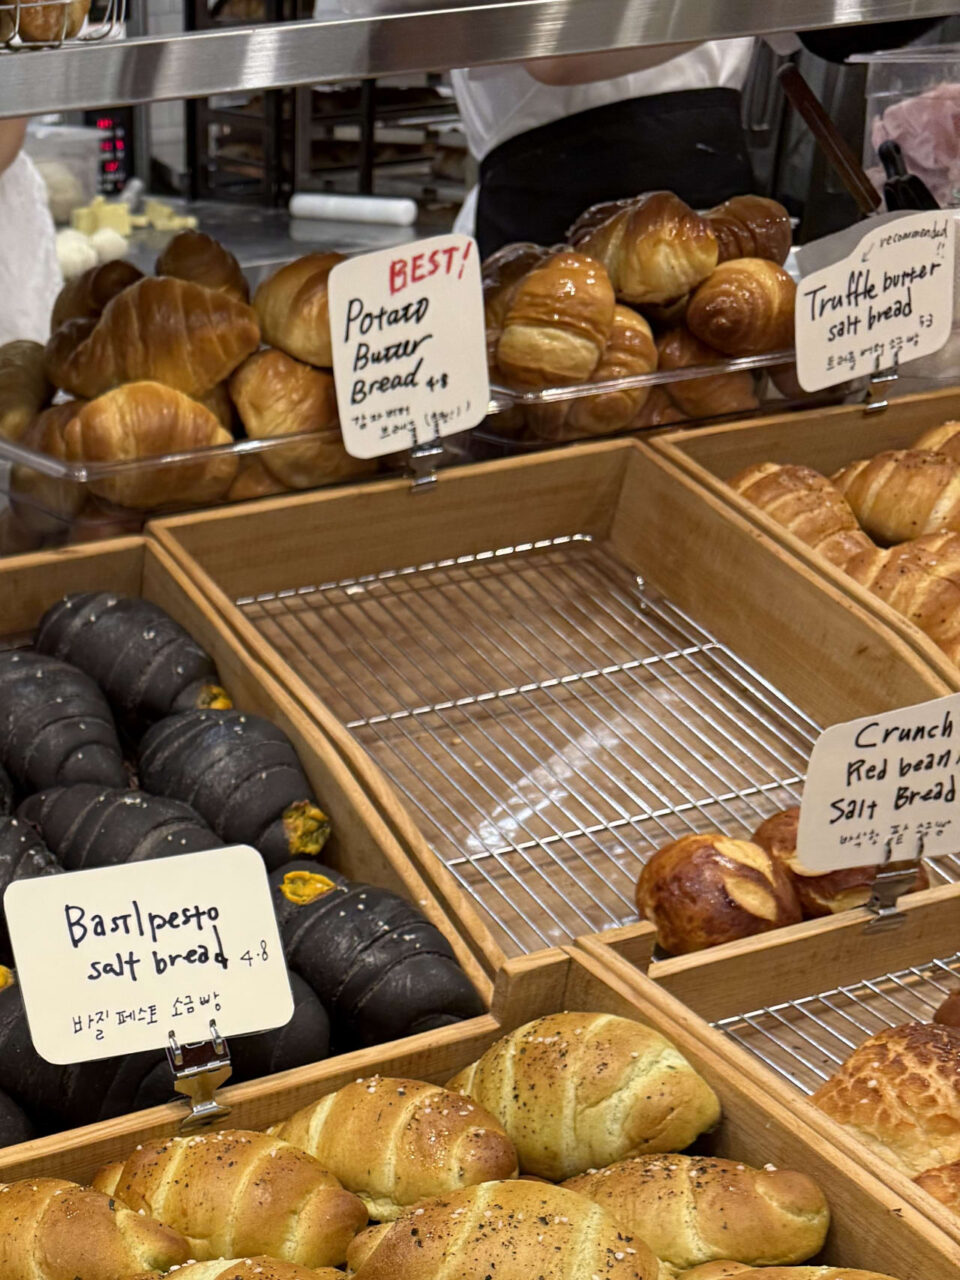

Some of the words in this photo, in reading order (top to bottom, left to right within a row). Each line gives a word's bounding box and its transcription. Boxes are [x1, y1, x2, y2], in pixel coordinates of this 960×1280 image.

[389, 240, 472, 296] BEST!
[804, 269, 877, 321] Truffle
[883, 262, 941, 292] butter
[345, 297, 429, 343] Potato
[827, 315, 861, 342] salt
[868, 287, 913, 330] bread
[353, 334, 433, 372] Butter
[351, 357, 424, 405] Bread
[855, 711, 954, 748] Crunch
[847, 758, 888, 787] Red
[899, 749, 952, 778] bean
[829, 798, 877, 825] Salt
[894, 775, 955, 810] Bread
[148, 905, 219, 942] pesto
[87, 951, 141, 981] salt
[152, 925, 229, 975] bread
[240, 940, 268, 967] 4.8
[171, 992, 221, 1018] 소금빵
